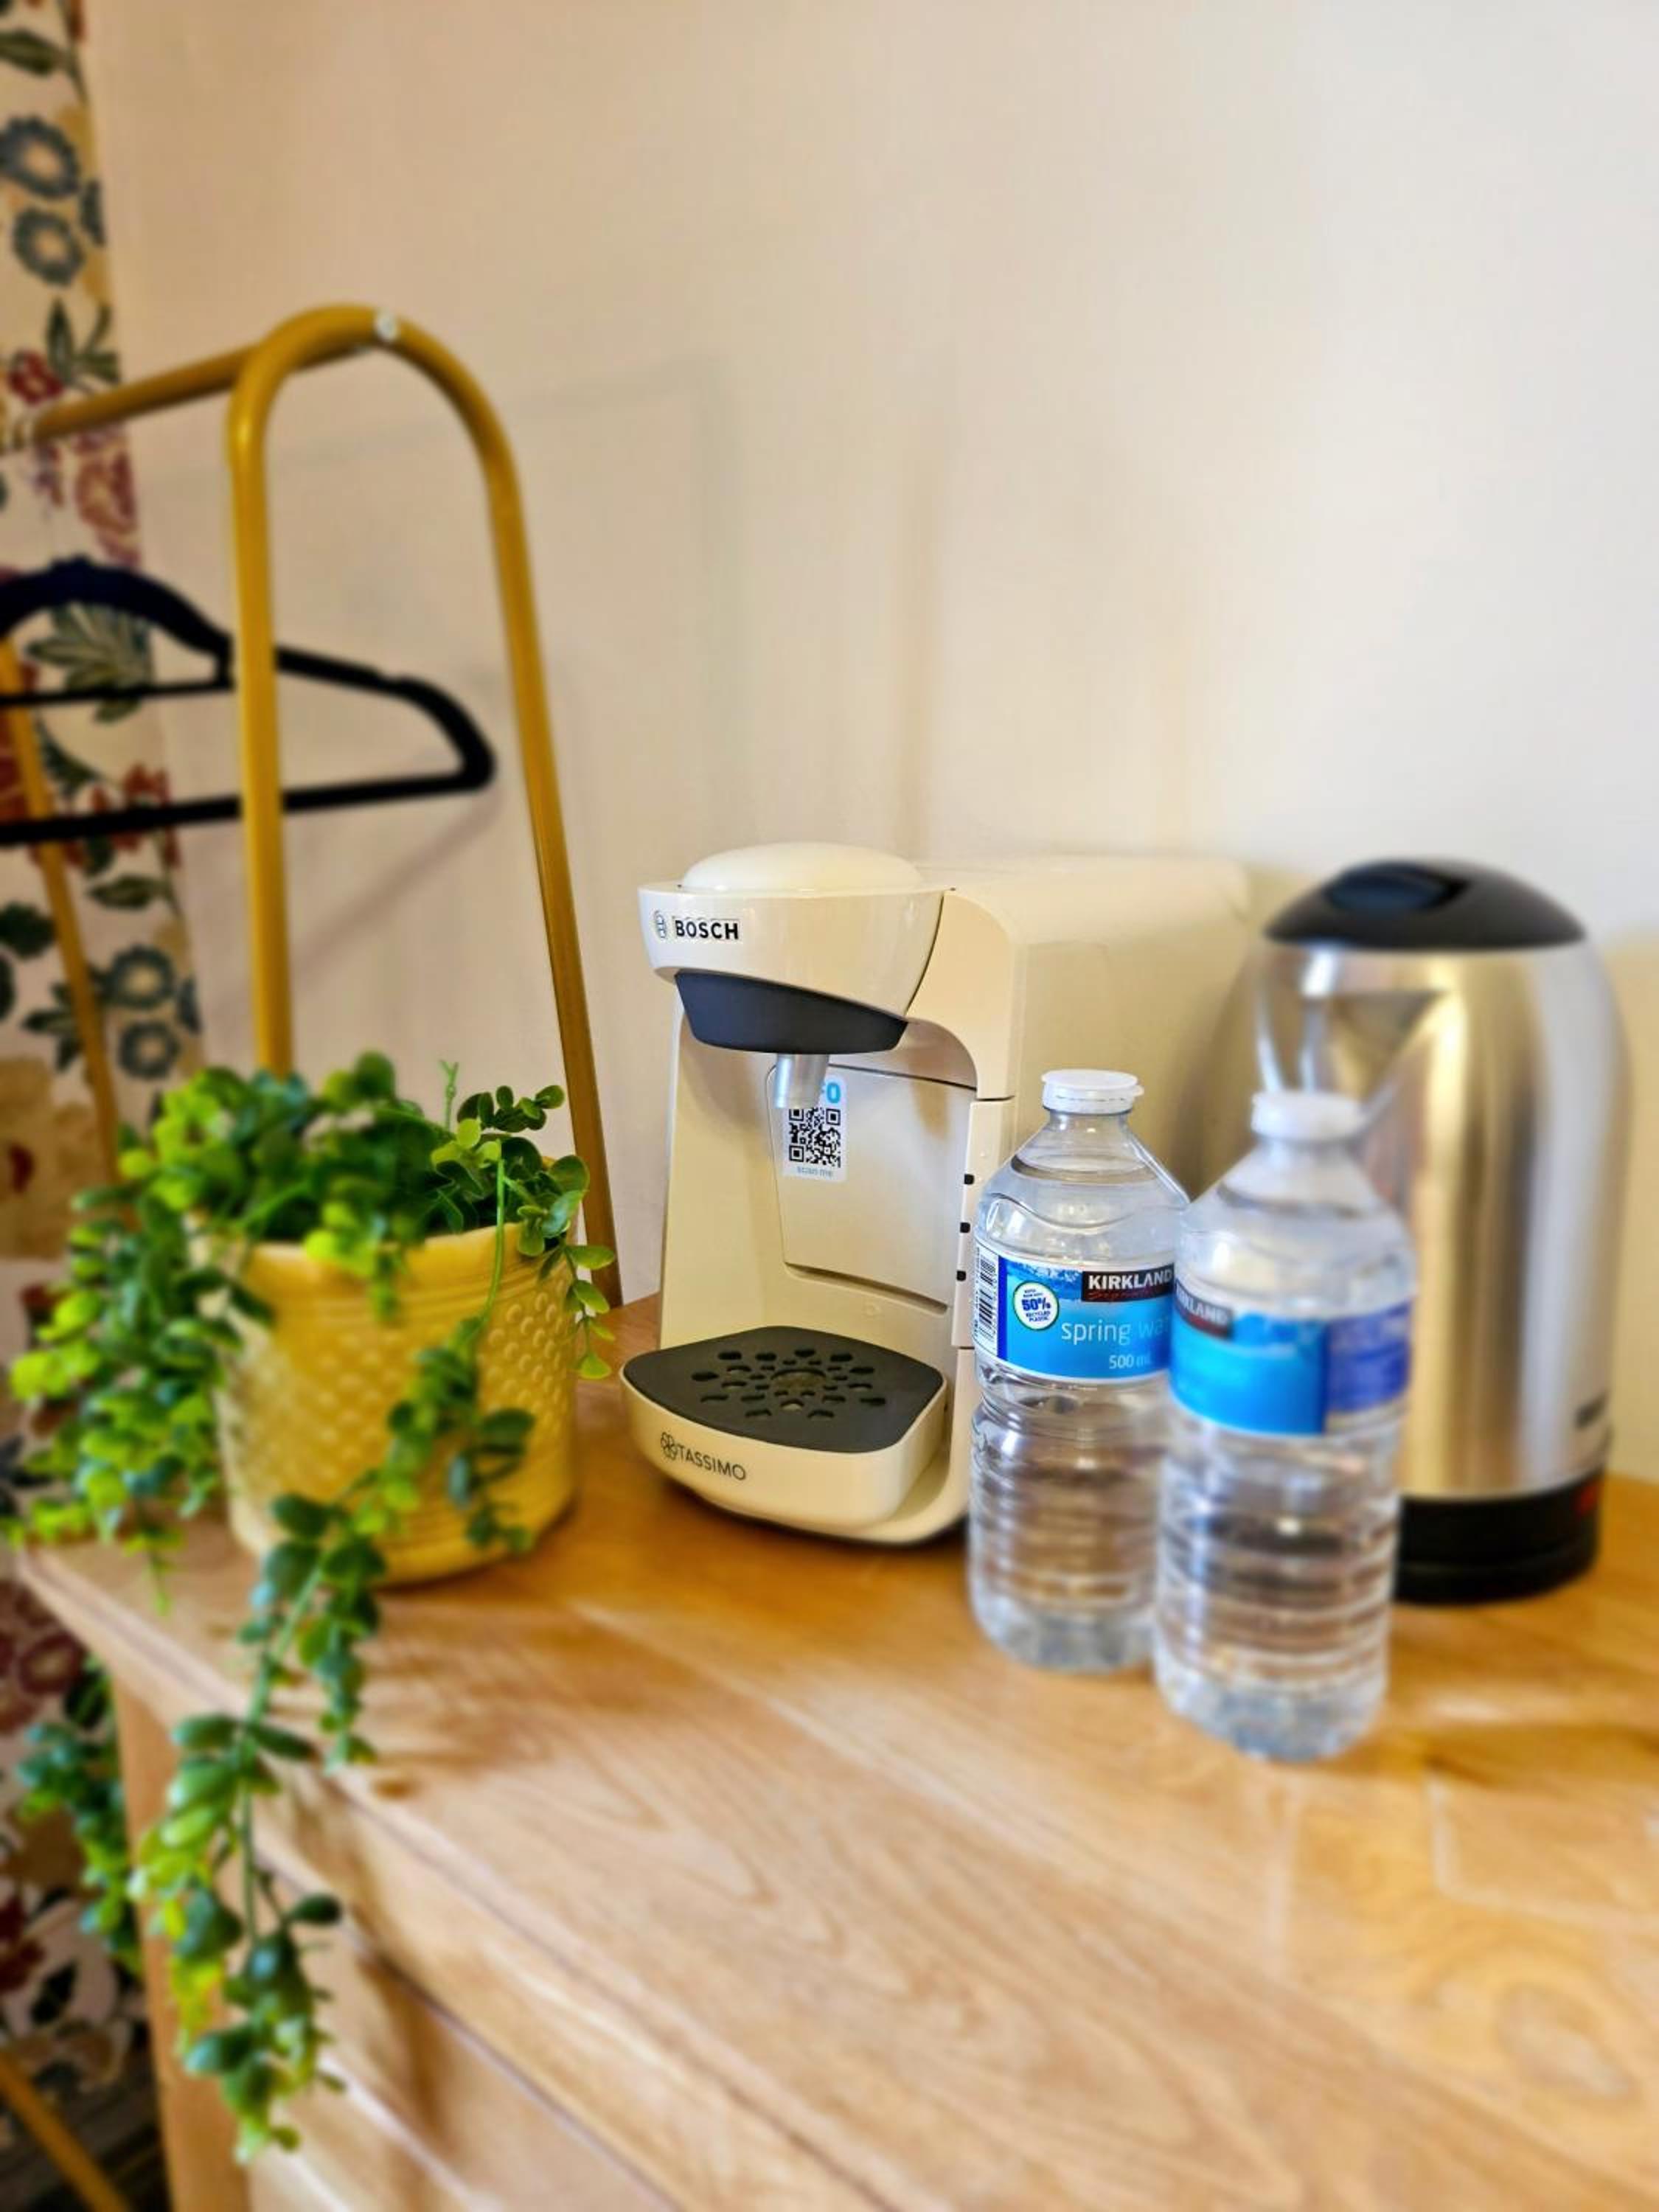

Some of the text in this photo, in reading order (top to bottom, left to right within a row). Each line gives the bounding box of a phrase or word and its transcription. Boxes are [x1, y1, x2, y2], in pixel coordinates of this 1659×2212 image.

[675, 919, 739, 940] BOSCH
[1088, 1269, 1173, 1290] KIRKLAND
[1021, 1298, 1051, 1311] 50%
[1061, 1319, 1131, 1346] spring
[1109, 1354, 1133, 1369] 500
[676, 1443, 747, 1481] TASSIMO
